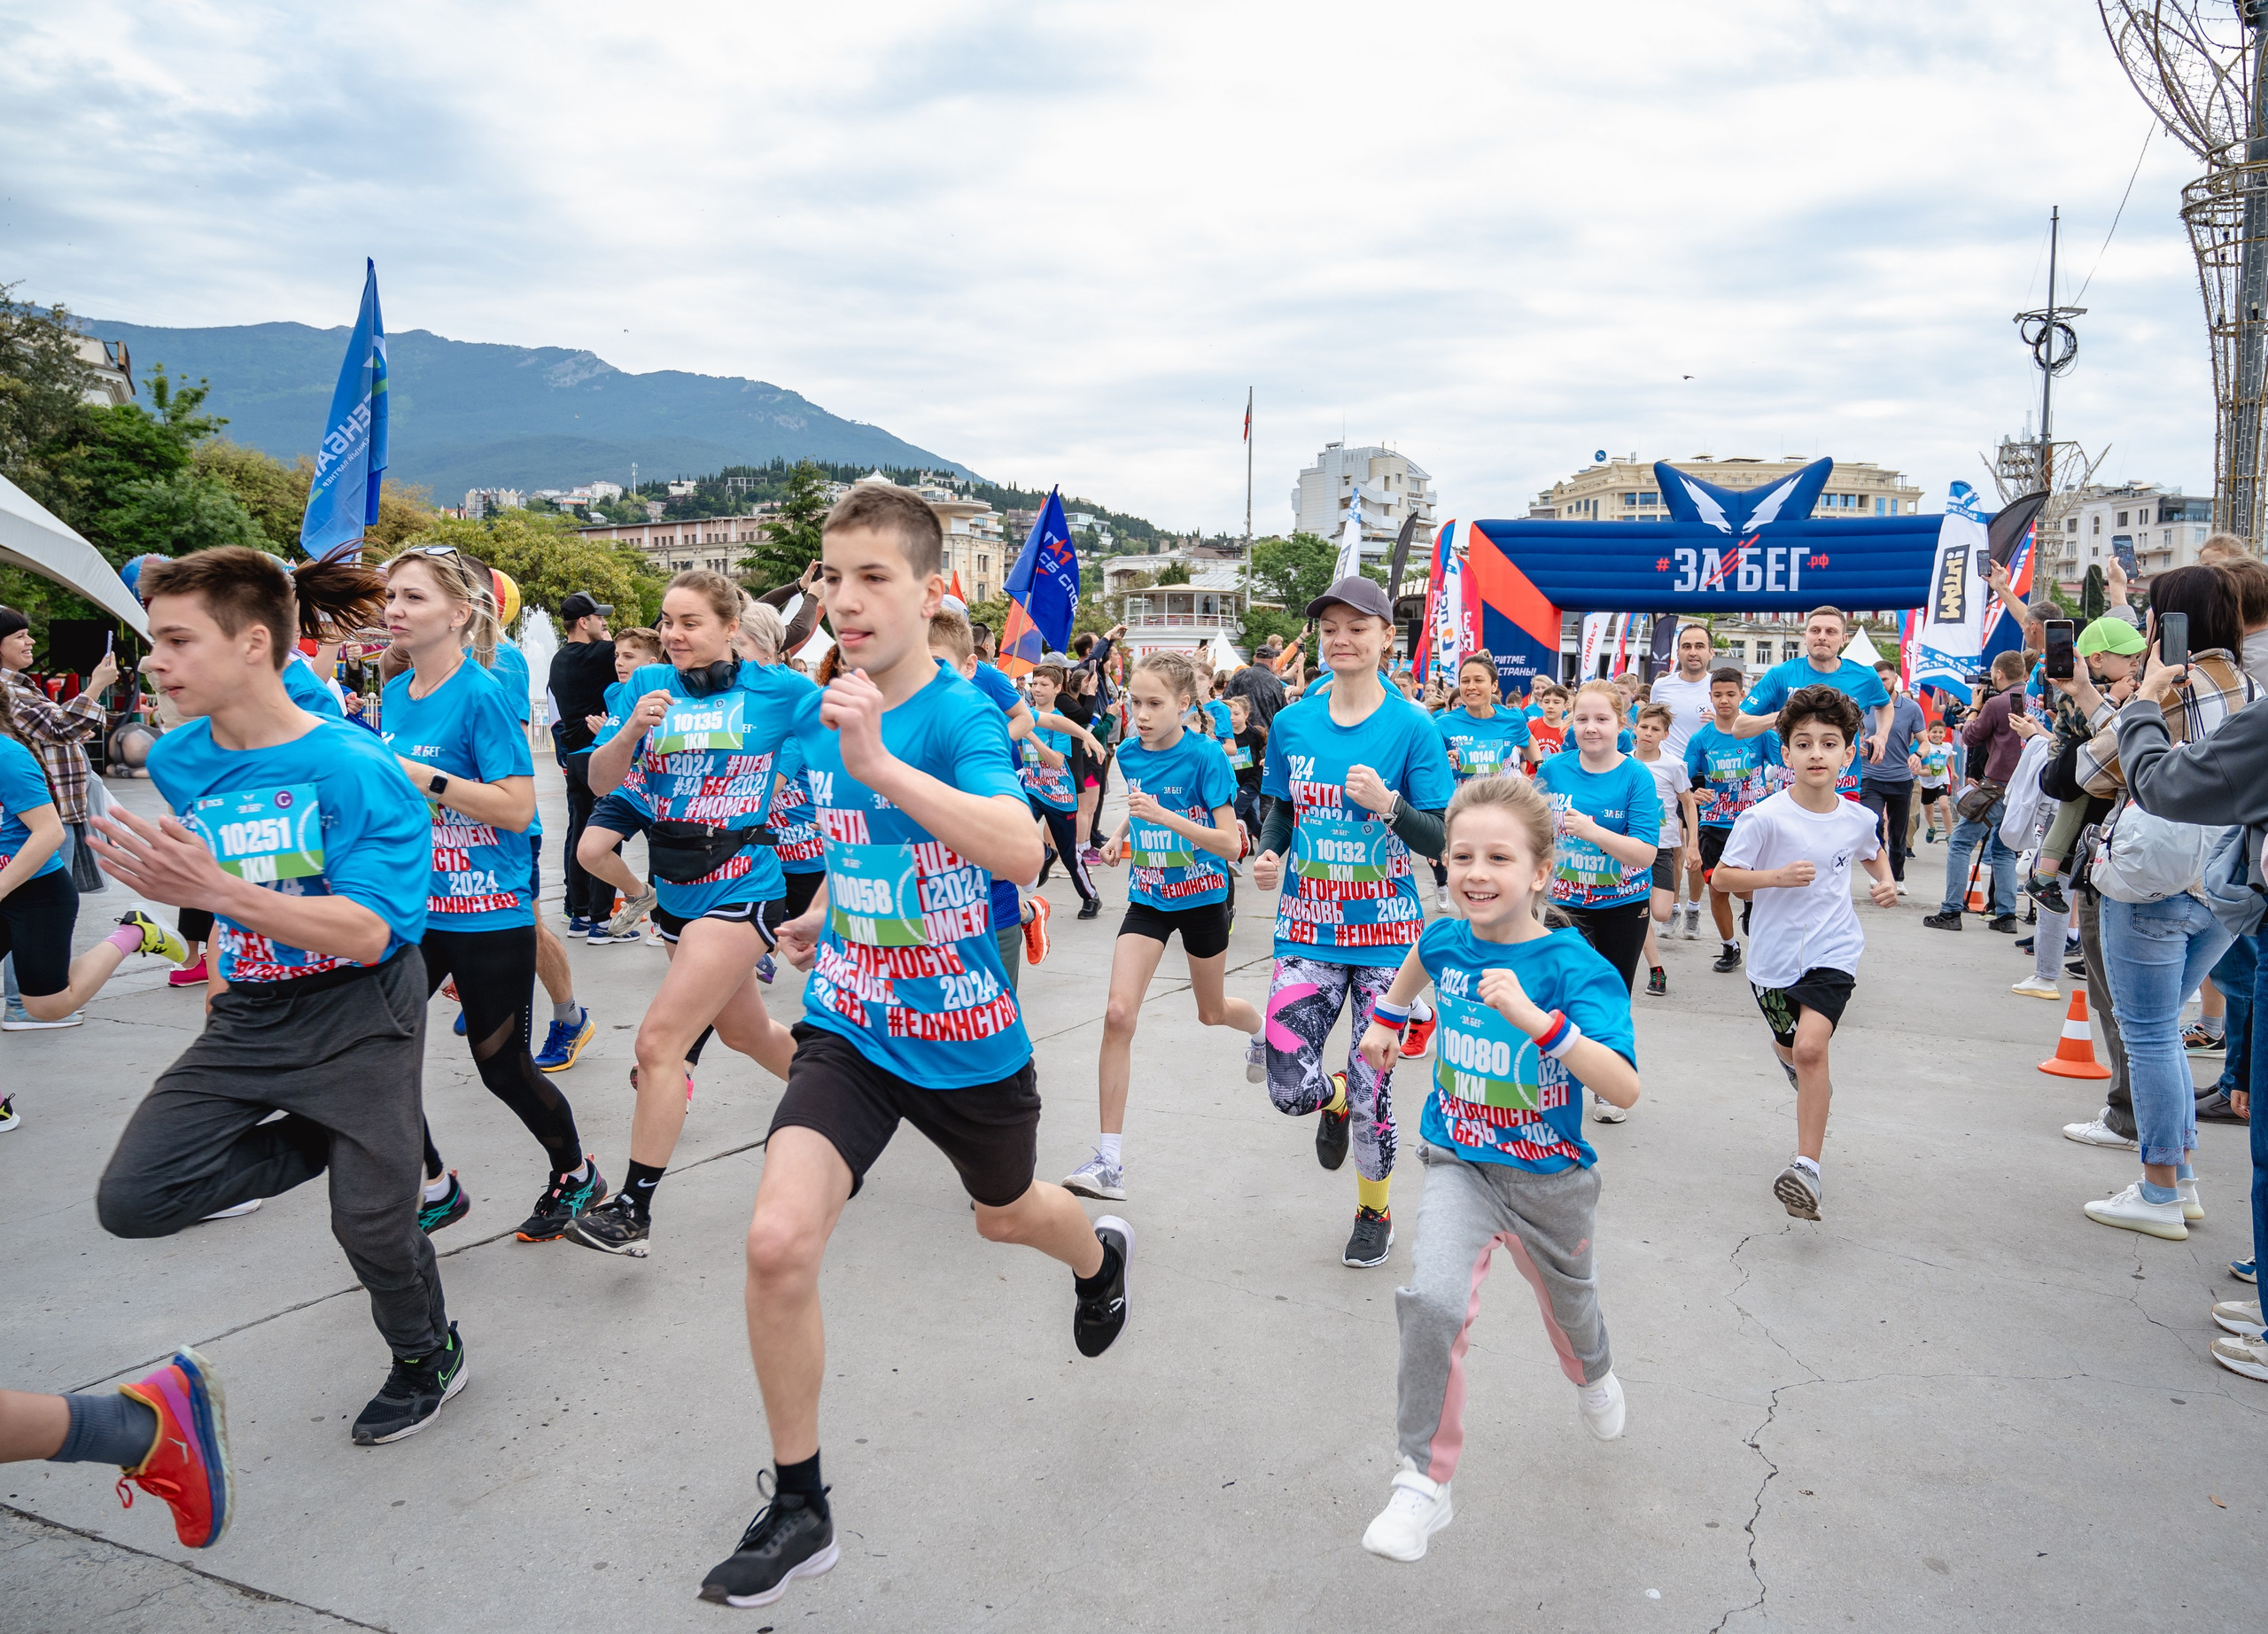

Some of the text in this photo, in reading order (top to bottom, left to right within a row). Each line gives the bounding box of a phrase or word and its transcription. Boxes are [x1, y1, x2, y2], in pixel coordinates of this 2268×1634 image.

[1497, 666, 1537, 677] СТРАНЫ!
[672, 710, 724, 733] 10135
[683, 732, 710, 751] 1КМ
[1468, 750, 1495, 764] 10146
[1716, 758, 1742, 770] 10077
[218, 816, 293, 857] 10251
[774, 821, 816, 845] 2024
[1139, 829, 1172, 850] 10117
[1146, 852, 1168, 868] 1КМ
[1316, 838, 1366, 863] 10132
[1568, 852, 1606, 872] 10137
[238, 854, 278, 884] 1КМ
[1184, 860, 1215, 881] 2024
[1327, 863, 1354, 883] 1КМ
[1577, 871, 1597, 886] 1КМ
[448, 870, 500, 896] 2024
[833, 871, 894, 914] 10058
[1160, 872, 1226, 899] #ЕДИНСТВО
[1376, 896, 1418, 923] 2024
[847, 914, 879, 946] 1КМ
[939, 966, 999, 1010] 2024
[1440, 966, 1471, 998] 2024
[885, 988, 1019, 1042] #ЕДИНСТВО
[1443, 1026, 1511, 1078] 10080
[1453, 1070, 1487, 1106] 1КМ
